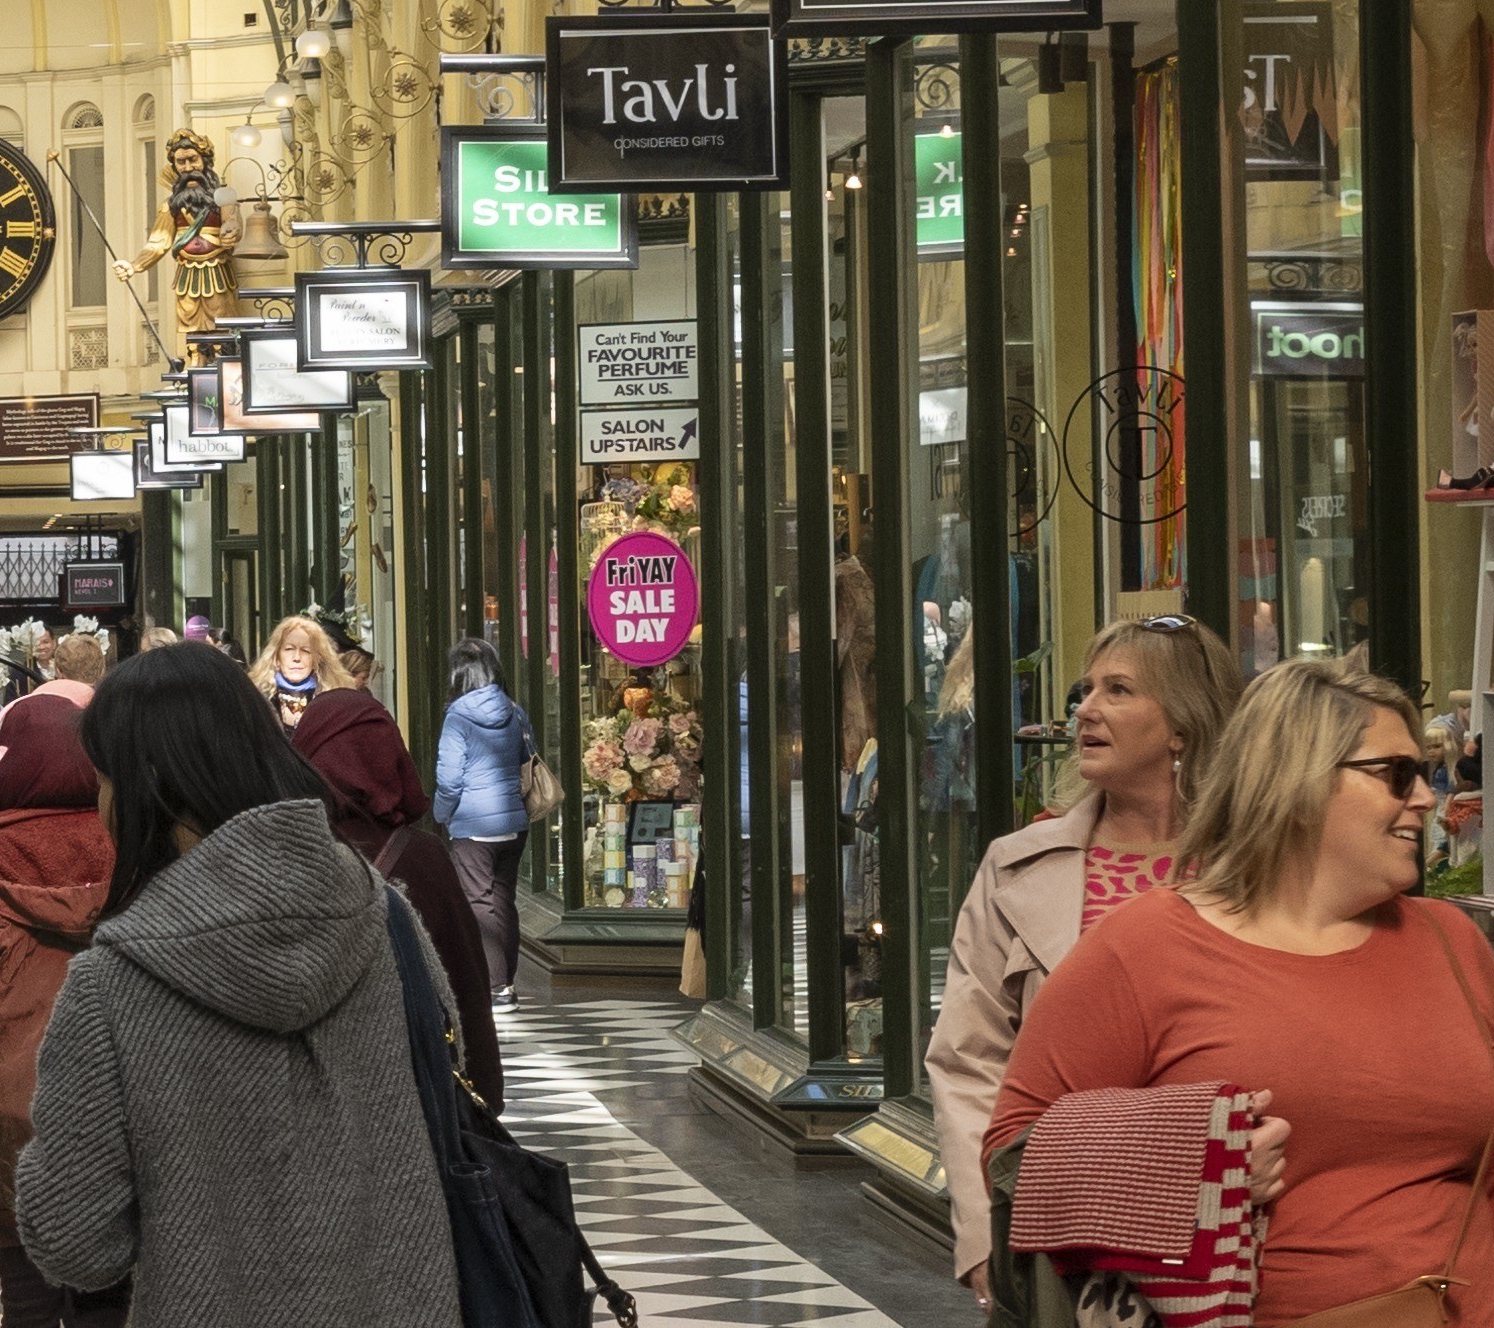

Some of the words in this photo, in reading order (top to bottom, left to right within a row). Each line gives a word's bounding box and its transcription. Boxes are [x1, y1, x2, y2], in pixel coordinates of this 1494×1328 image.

[587, 63, 740, 125] Tavli
[613, 135, 687, 151] CONSIDERED
[690, 133, 724, 148] GIFTS
[494, 165, 549, 193] SIL
[472, 198, 607, 227] STORE
[595, 332, 626, 346] Can't
[630, 331, 656, 344] Find
[660, 330, 688, 343] Your
[588, 345, 697, 363] FAVOURITE
[598, 360, 689, 378] PERFUME
[614, 383, 645, 396] ASK
[648, 382, 673, 395] US.
[601, 418, 665, 435] SALON
[590, 436, 676, 453] UPSTAIRS
[606, 555, 678, 586] FriYAY
[609, 589, 676, 615] SALE
[616, 618, 670, 643] DAY
